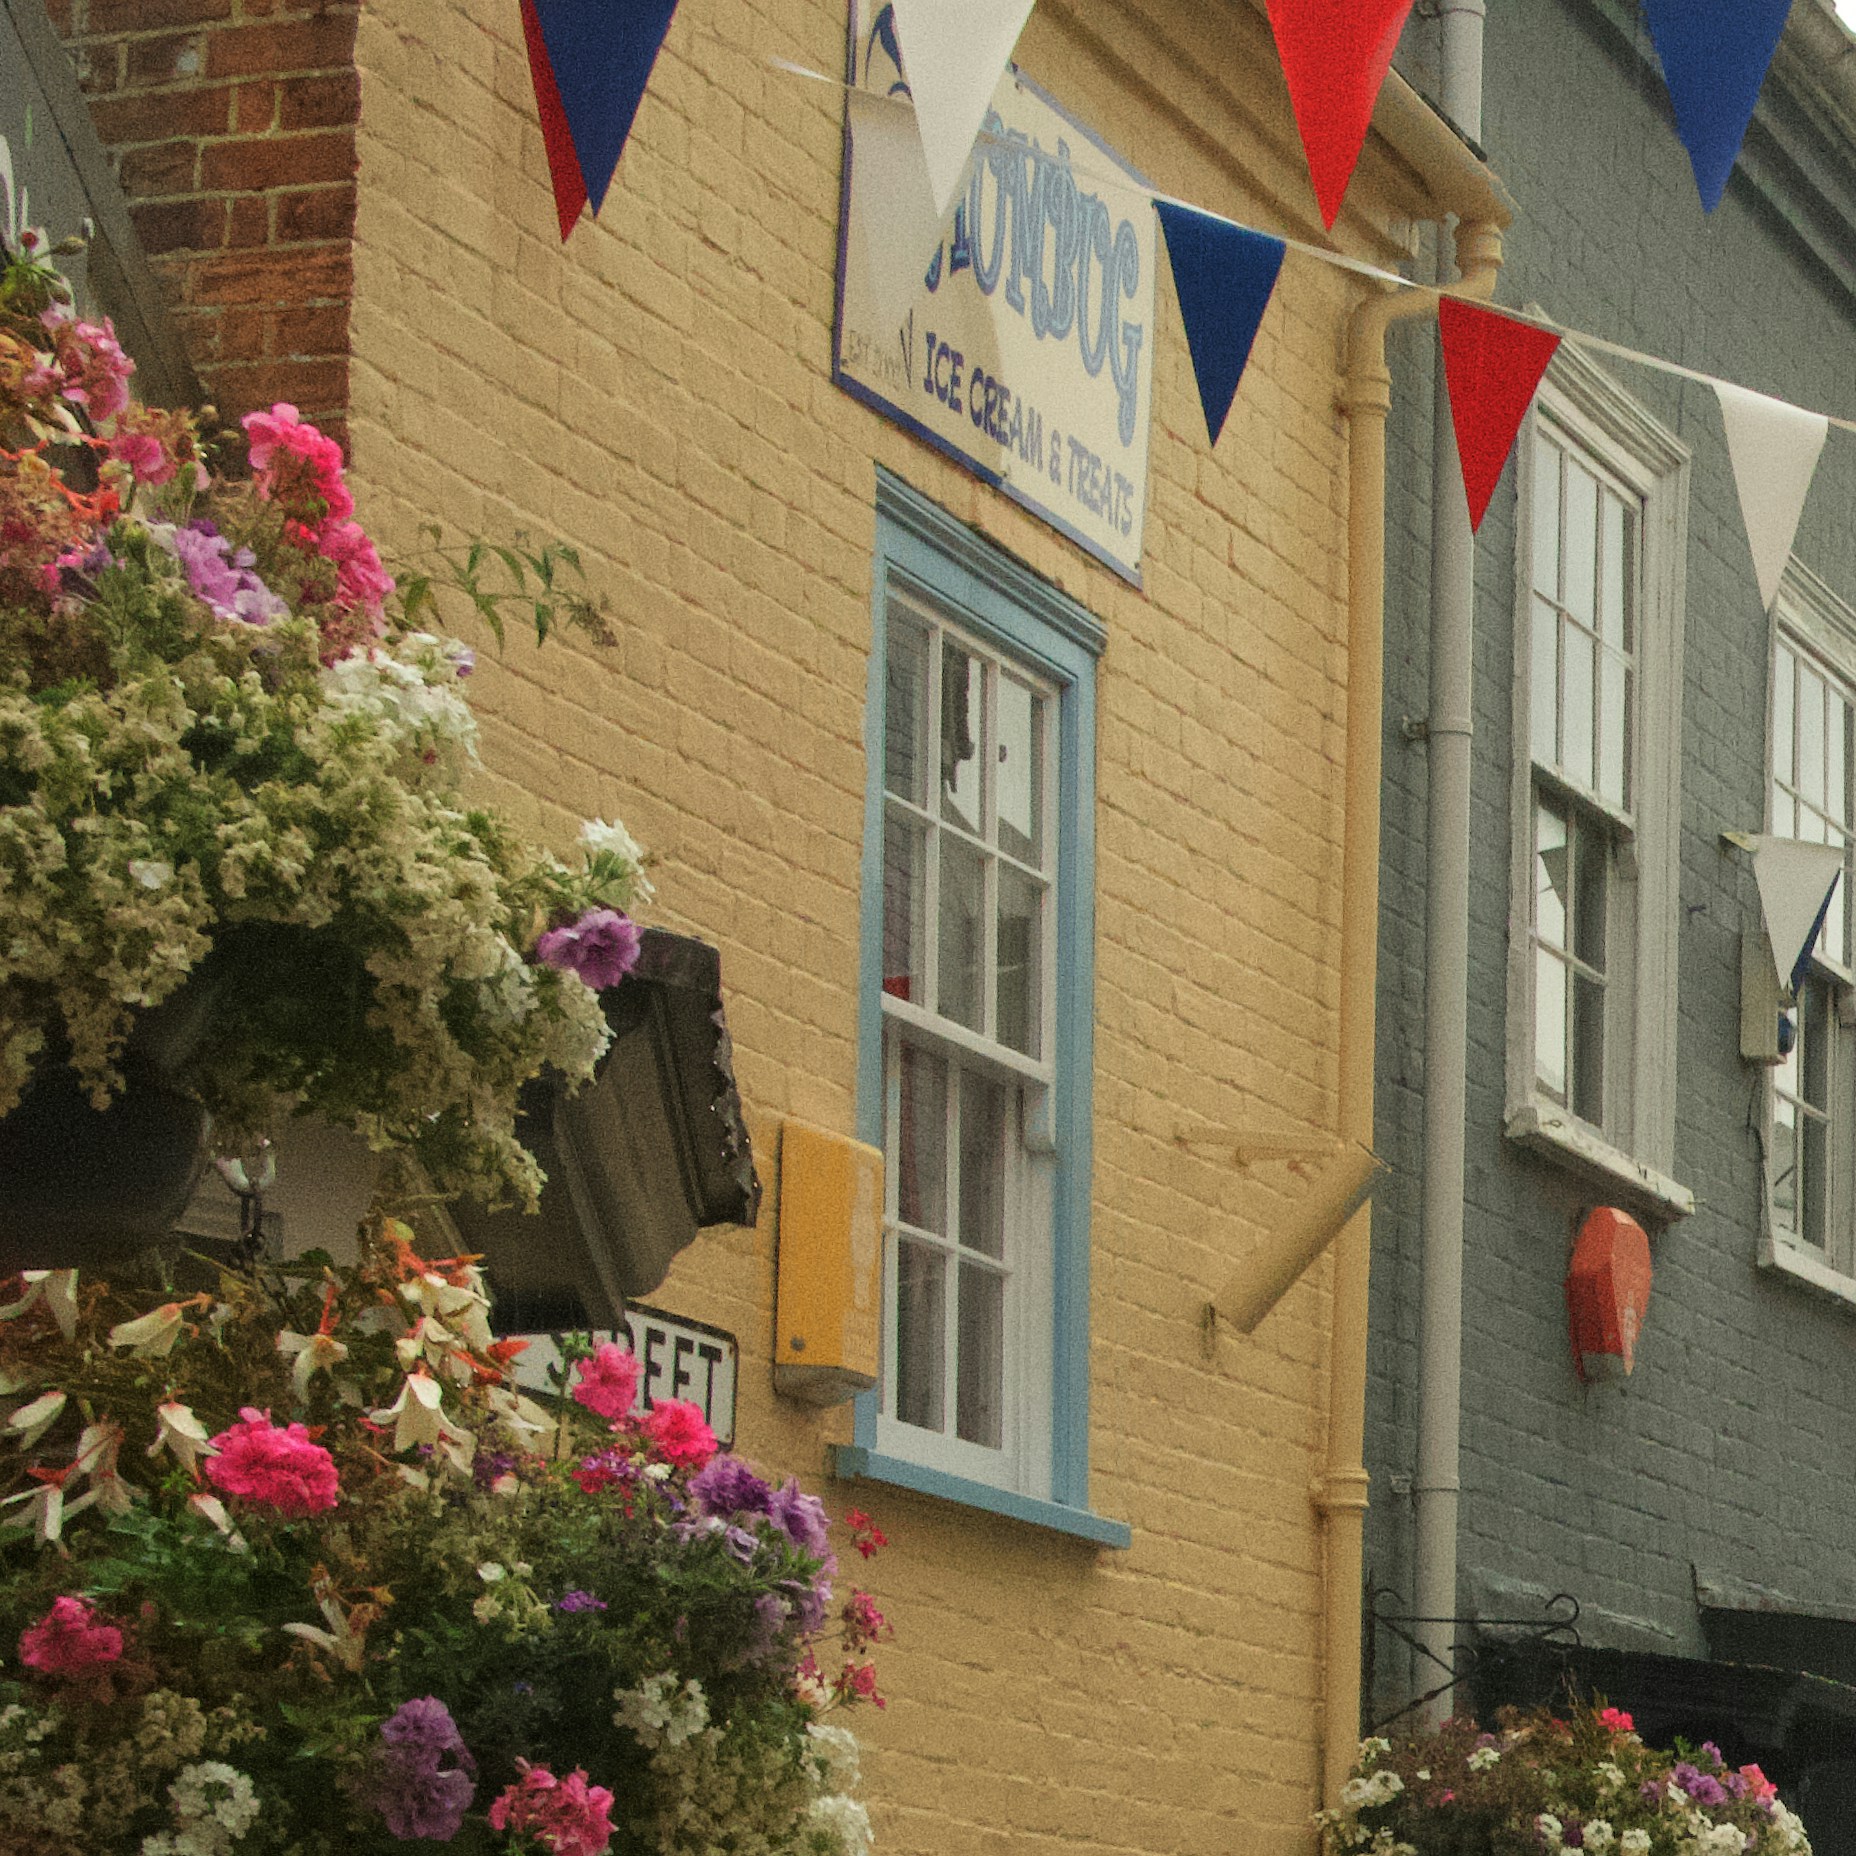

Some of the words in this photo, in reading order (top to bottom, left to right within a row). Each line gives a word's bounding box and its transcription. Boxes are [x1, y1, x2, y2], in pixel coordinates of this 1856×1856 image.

[923, 330, 965, 414] ICE
[968, 366, 1044, 474] CREAM
[1049, 429, 1062, 486] &
[1066, 434, 1134, 538] TREATS
